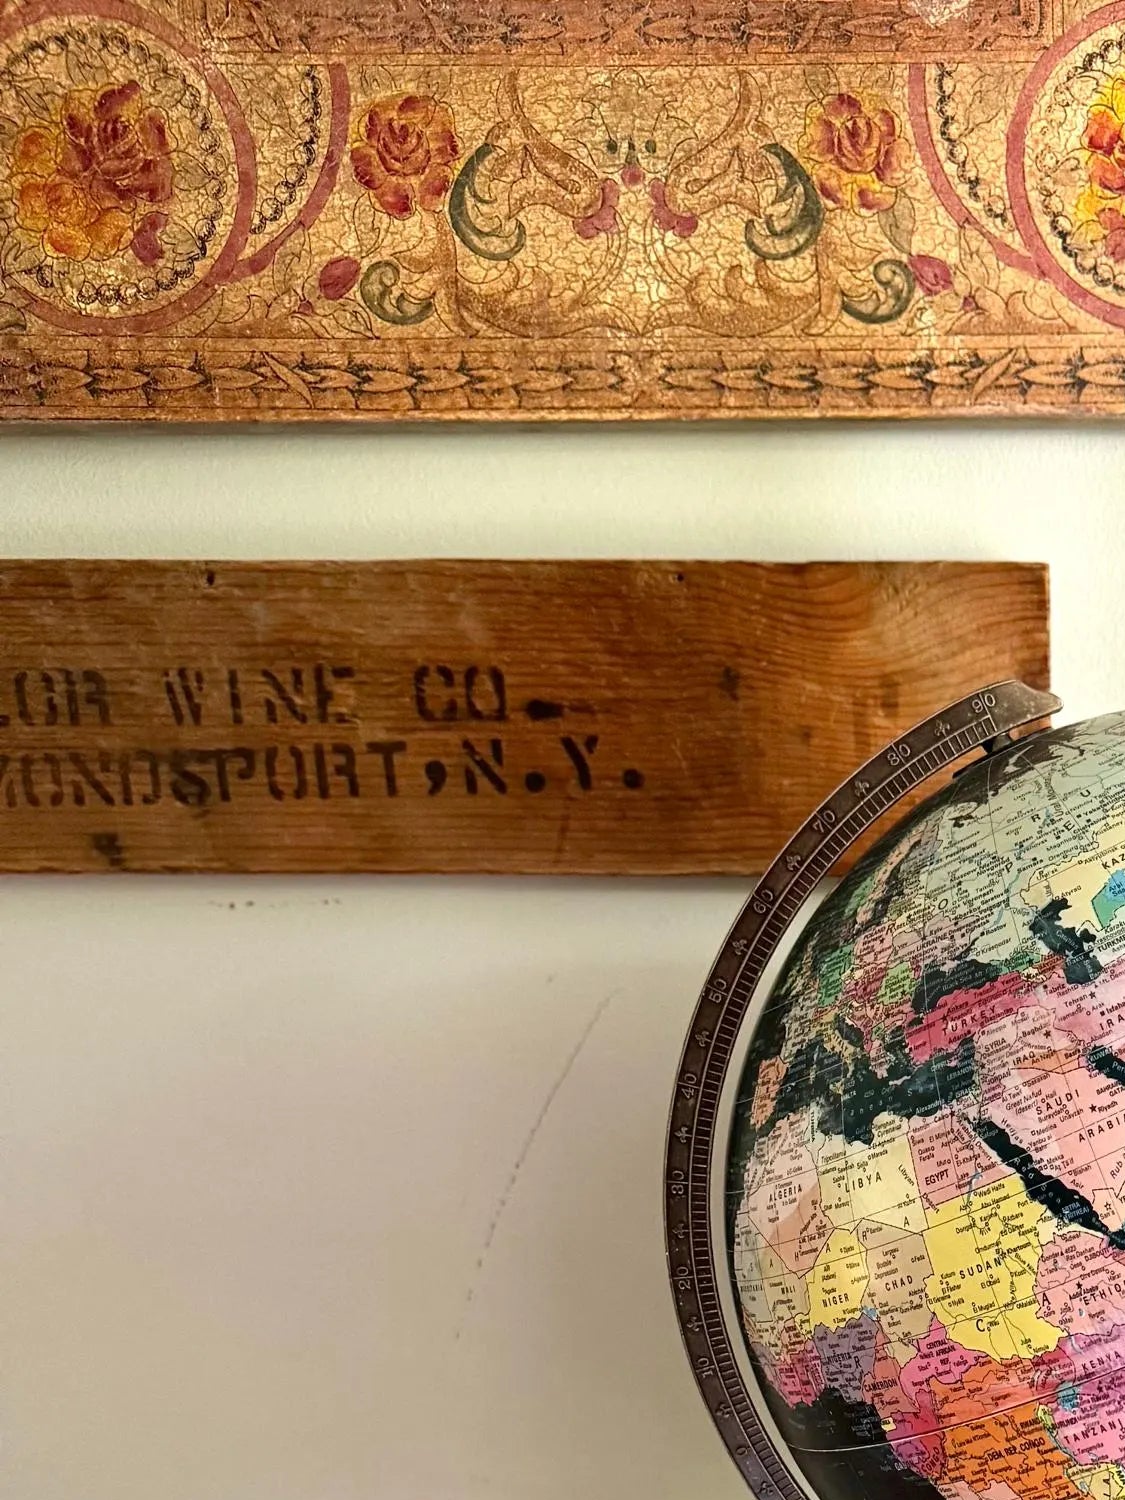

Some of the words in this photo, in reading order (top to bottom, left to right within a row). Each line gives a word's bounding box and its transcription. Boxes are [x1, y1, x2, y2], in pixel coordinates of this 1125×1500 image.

[0, 669, 113, 727] OR
[163, 664, 358, 725] WINE
[971, 693, 996, 714] 90
[886, 743, 911, 767] 80
[812, 809, 836, 834] 70
[753, 889, 774, 914] 60
[916, 932, 947, 952] UKRAINE
[708, 978, 727, 1004] 50
[1064, 993, 1088, 1008] Tehran
[942, 1005, 997, 1034] TURKEY
[984, 1038, 1007, 1052] SYRIA
[1012, 1051, 1036, 1066] IRAQ
[681, 1073, 698, 1099] 40
[1006, 1098, 1022, 1111] Great
[1035, 1089, 1081, 1115] SAUDI
[1097, 1100, 1118, 1113] Riyadh
[1036, 1123, 1057, 1135] Medina
[897, 1164, 915, 1187] Libyan
[924, 1168, 949, 1185] EGYPT
[1110, 1160, 1124, 1178] Rub
[671, 1170, 685, 1195] 30
[845, 1172, 882, 1193] LIBYA
[978, 1186, 990, 1197] Wadi
[769, 1184, 803, 1202] ALGERIA
[681, 1266, 691, 1290] 20
[958, 1257, 1002, 1280] SUDAN
[885, 1275, 913, 1292] CHAD
[822, 1292, 850, 1307] NIGER
[926, 1339, 948, 1349] CENTRAL
[1082, 1351, 1122, 1370] KENYA
[864, 1378, 898, 1393] CAMEROON
[1019, 1437, 1046, 1452] CONGO
